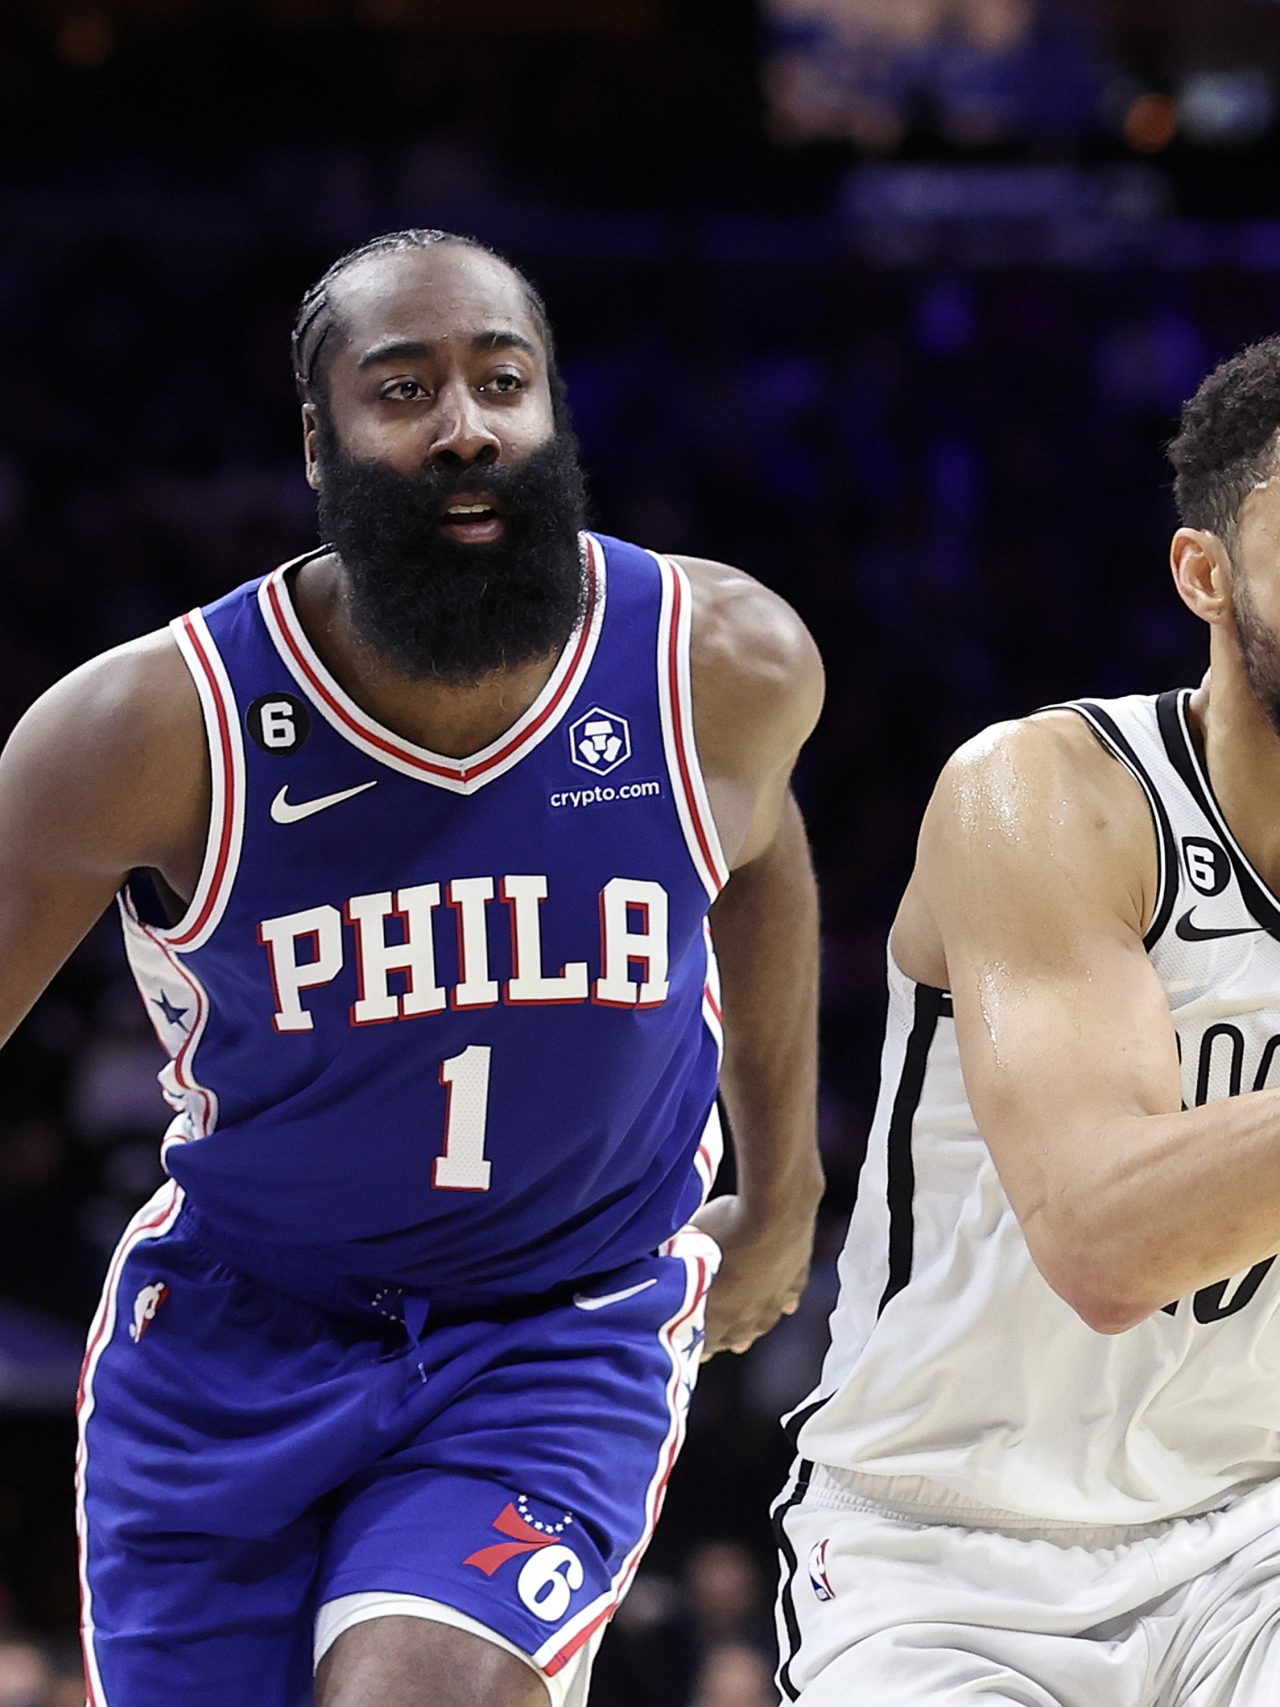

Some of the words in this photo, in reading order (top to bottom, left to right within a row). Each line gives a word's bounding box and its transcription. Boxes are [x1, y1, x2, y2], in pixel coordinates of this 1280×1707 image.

[261, 702, 296, 748] 6
[550, 782, 660, 807] crypto.com
[1186, 844, 1215, 891] 6
[257, 875, 669, 1033] PHILA
[432, 1045, 492, 1191] 1
[463, 1502, 584, 1622] 76
